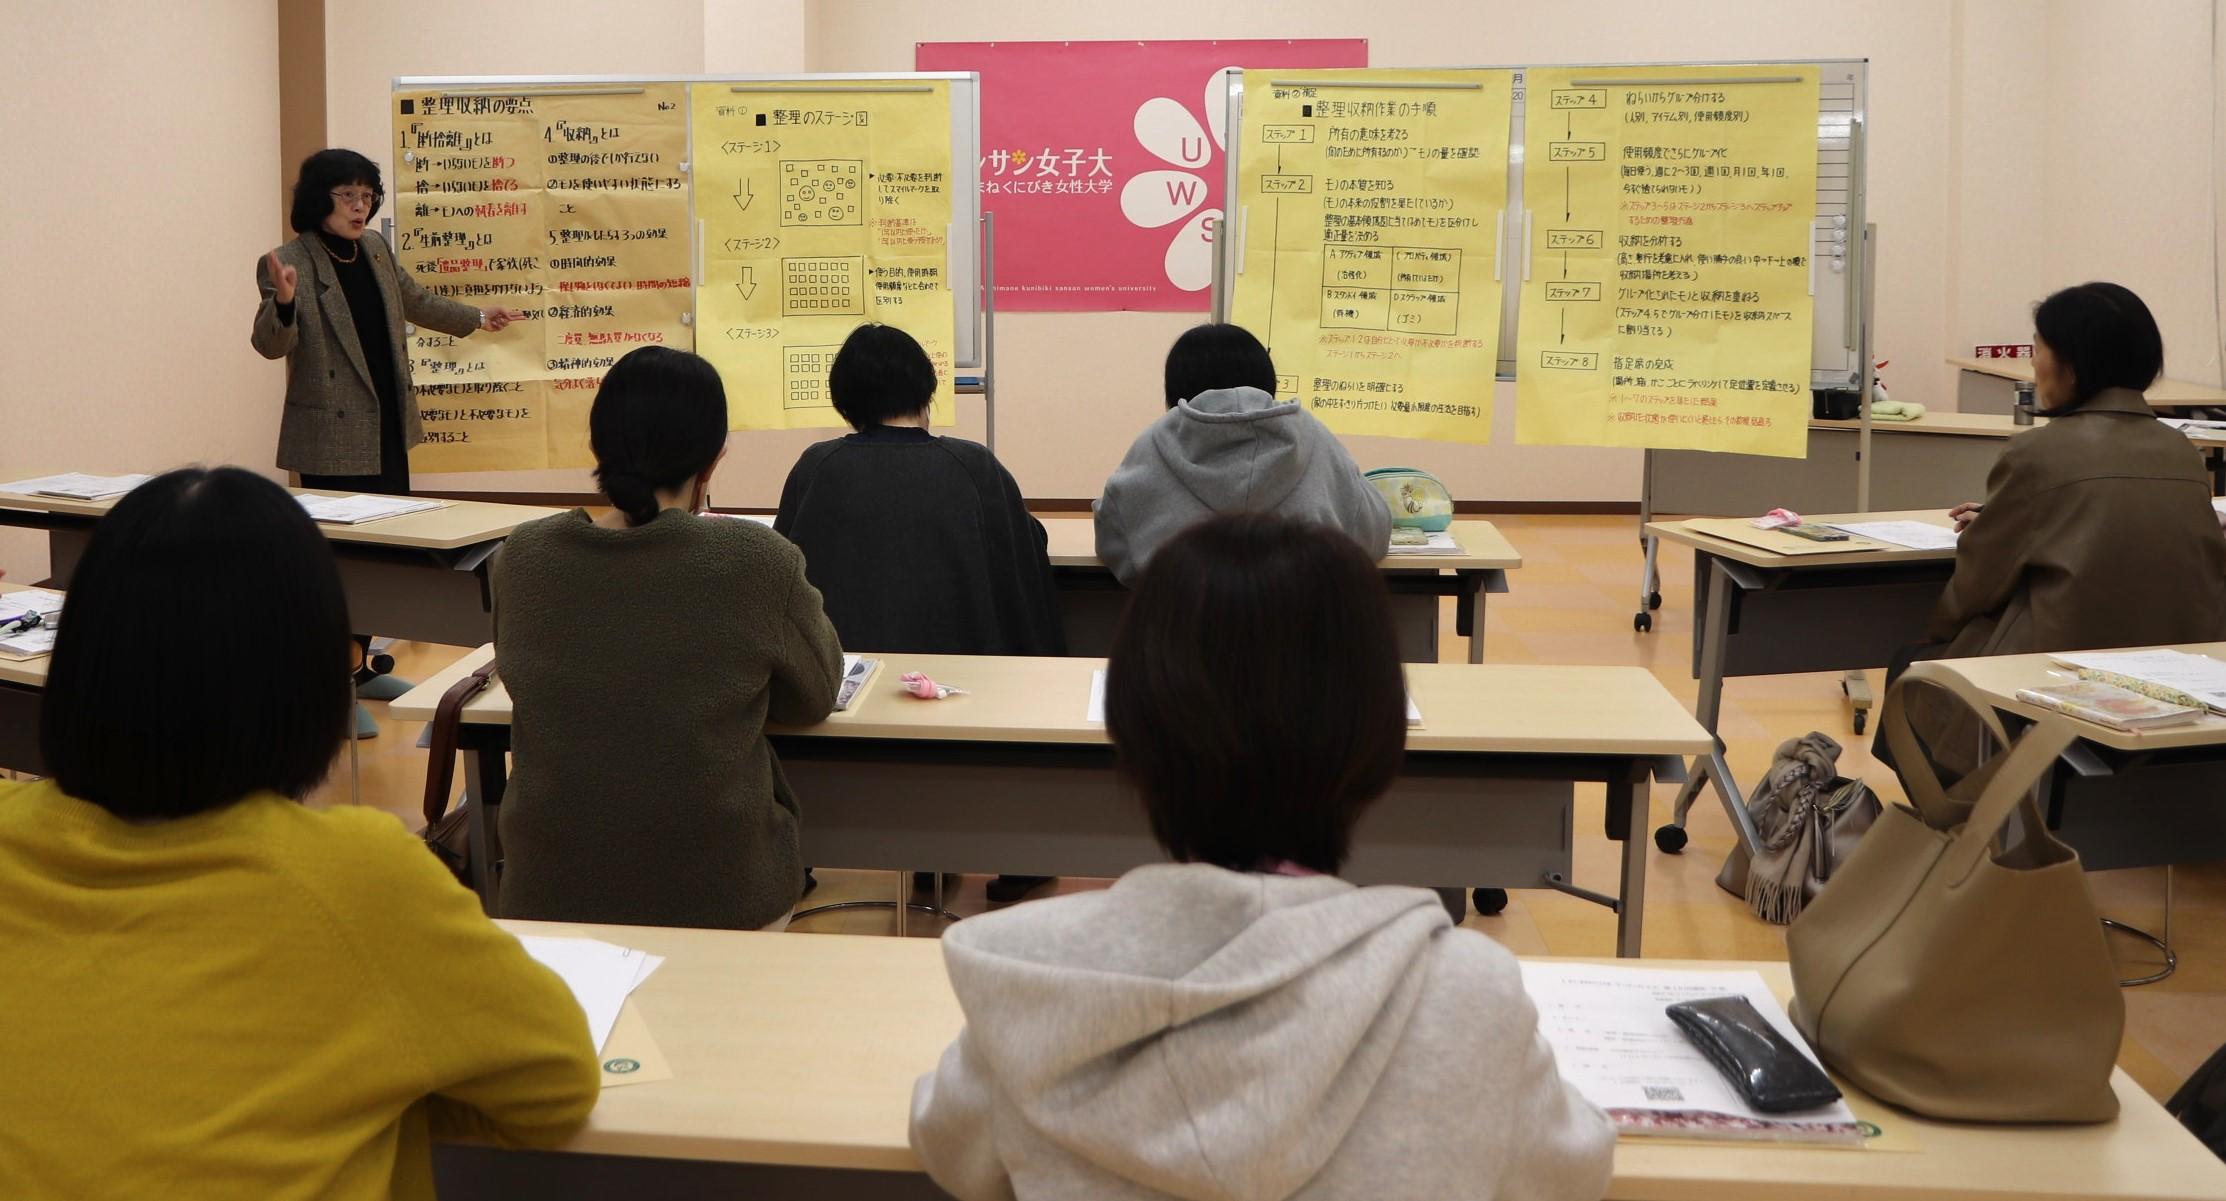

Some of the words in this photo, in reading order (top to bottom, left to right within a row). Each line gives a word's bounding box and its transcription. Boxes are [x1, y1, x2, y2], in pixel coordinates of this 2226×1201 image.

[421, 97, 534, 115] 整理収納の要点
[1316, 100, 1438, 118] 整理収納作業の手順
[1327, 127, 1409, 141] 所有の意味を考える
[1182, 137, 1202, 162] U
[1325, 178, 1394, 191] モノの本質を知る
[1166, 181, 1198, 205] W
[559, 203, 576, 213] こと
[550, 255, 617, 270] ①時間的効果
[548, 305, 615, 320] ②経済的効果
[1977, 347, 2031, 359] 消火器
